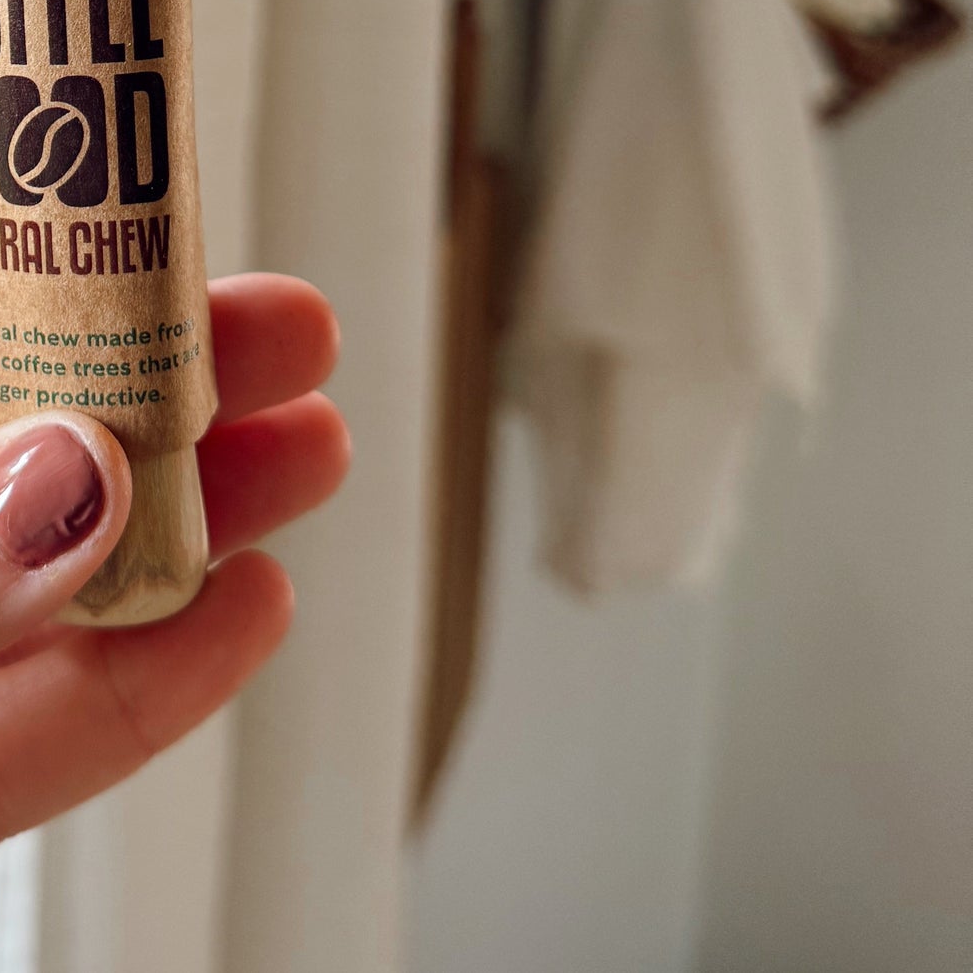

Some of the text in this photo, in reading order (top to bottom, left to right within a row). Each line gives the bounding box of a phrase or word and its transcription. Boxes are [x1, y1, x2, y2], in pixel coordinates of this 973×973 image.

[68, 215, 171, 275] CHEW
[23, 327, 78, 347] chew
[87, 327, 152, 347] made
[1, 352, 67, 376] coffee
[73, 358, 131, 376] trees
[138, 353, 179, 374] that
[36, 386, 166, 408] productive.
